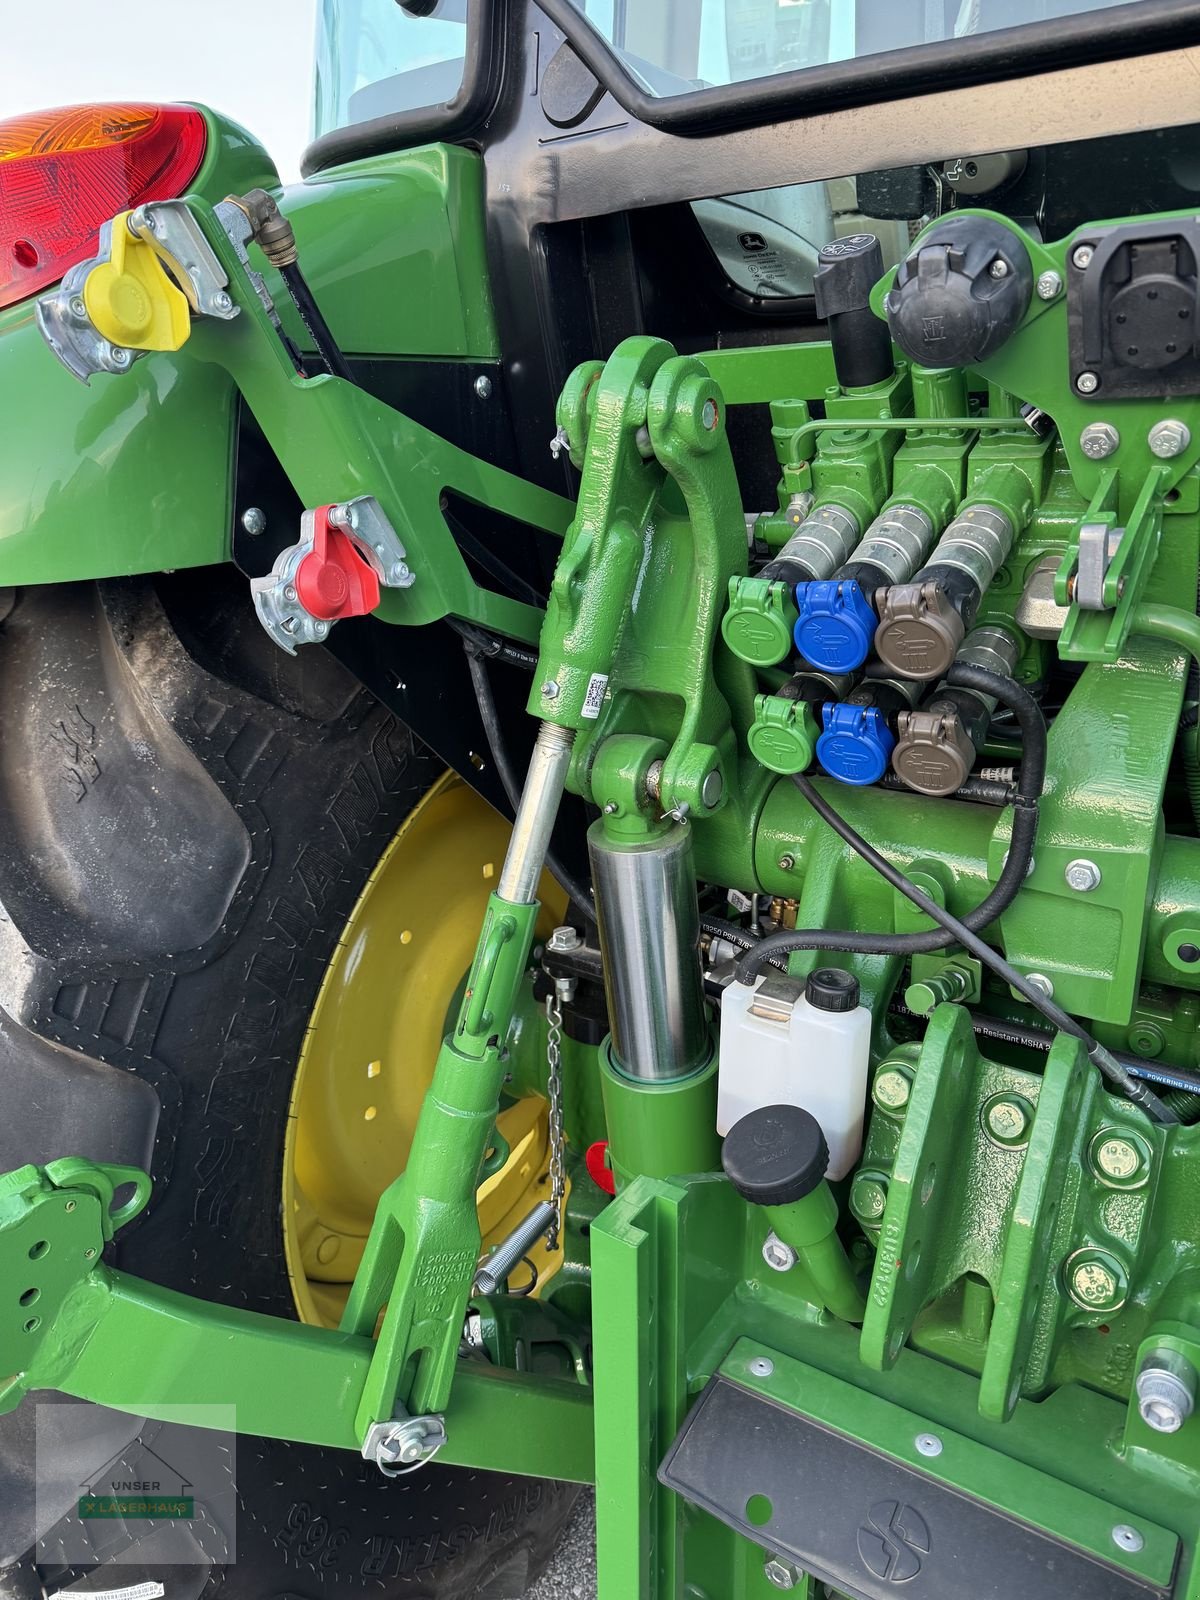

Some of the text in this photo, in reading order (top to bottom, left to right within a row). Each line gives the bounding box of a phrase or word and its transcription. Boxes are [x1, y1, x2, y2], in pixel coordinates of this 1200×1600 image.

[203, 713, 430, 1122] ALLIANC
[982, 1026, 1020, 1043] Resistant
[1020, 1036, 1044, 1051] MSHA
[1147, 1073, 1183, 1088] POWERING
[273, 1502, 351, 1568] 365
